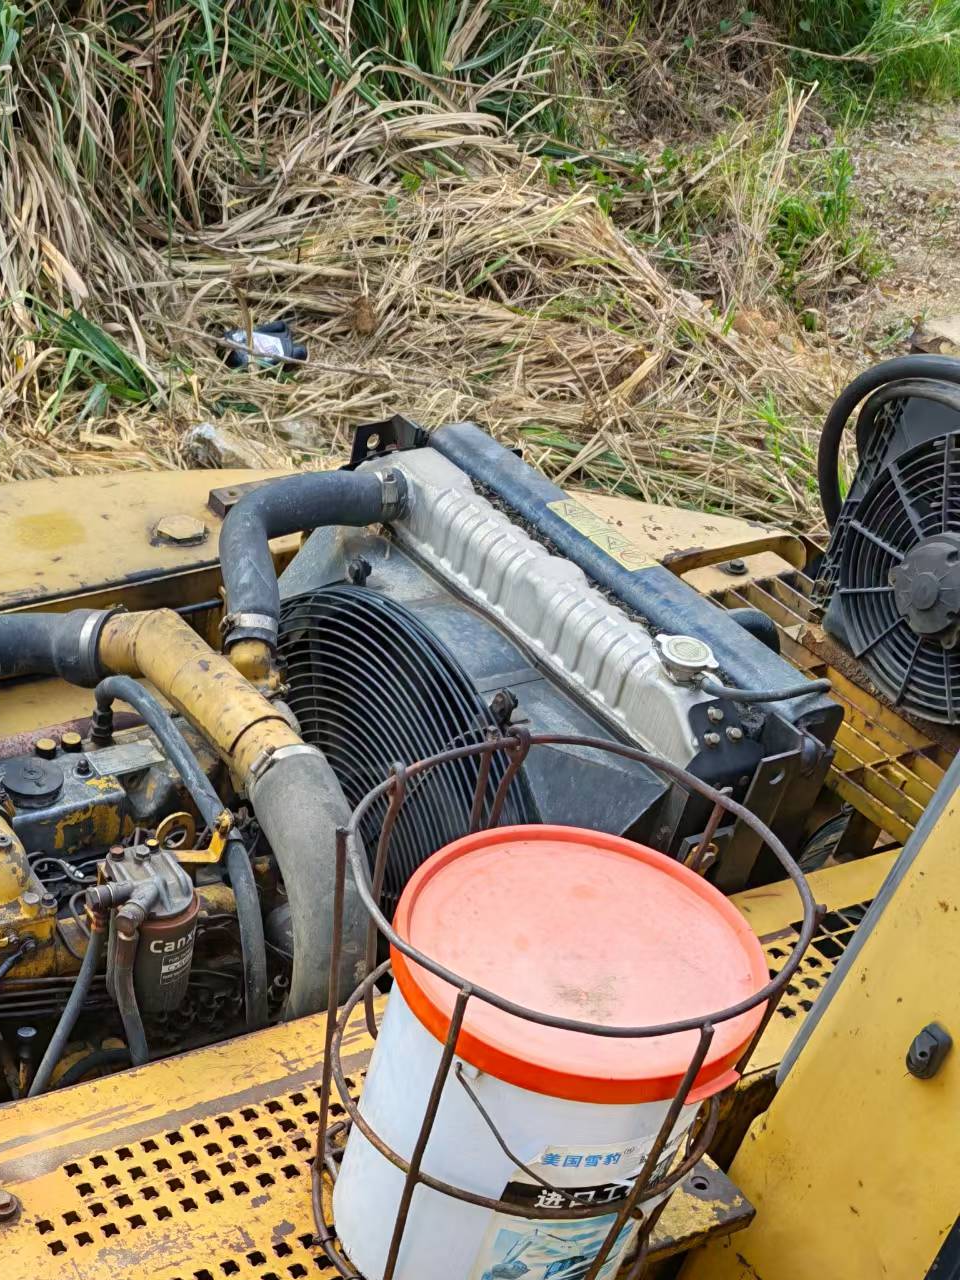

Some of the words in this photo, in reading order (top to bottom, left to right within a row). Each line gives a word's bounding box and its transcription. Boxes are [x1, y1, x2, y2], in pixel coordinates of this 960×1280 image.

[149, 929, 196, 954] Canx
[542, 1152, 622, 1168] 美国雪豹
[534, 1184, 633, 1209] 进口工
